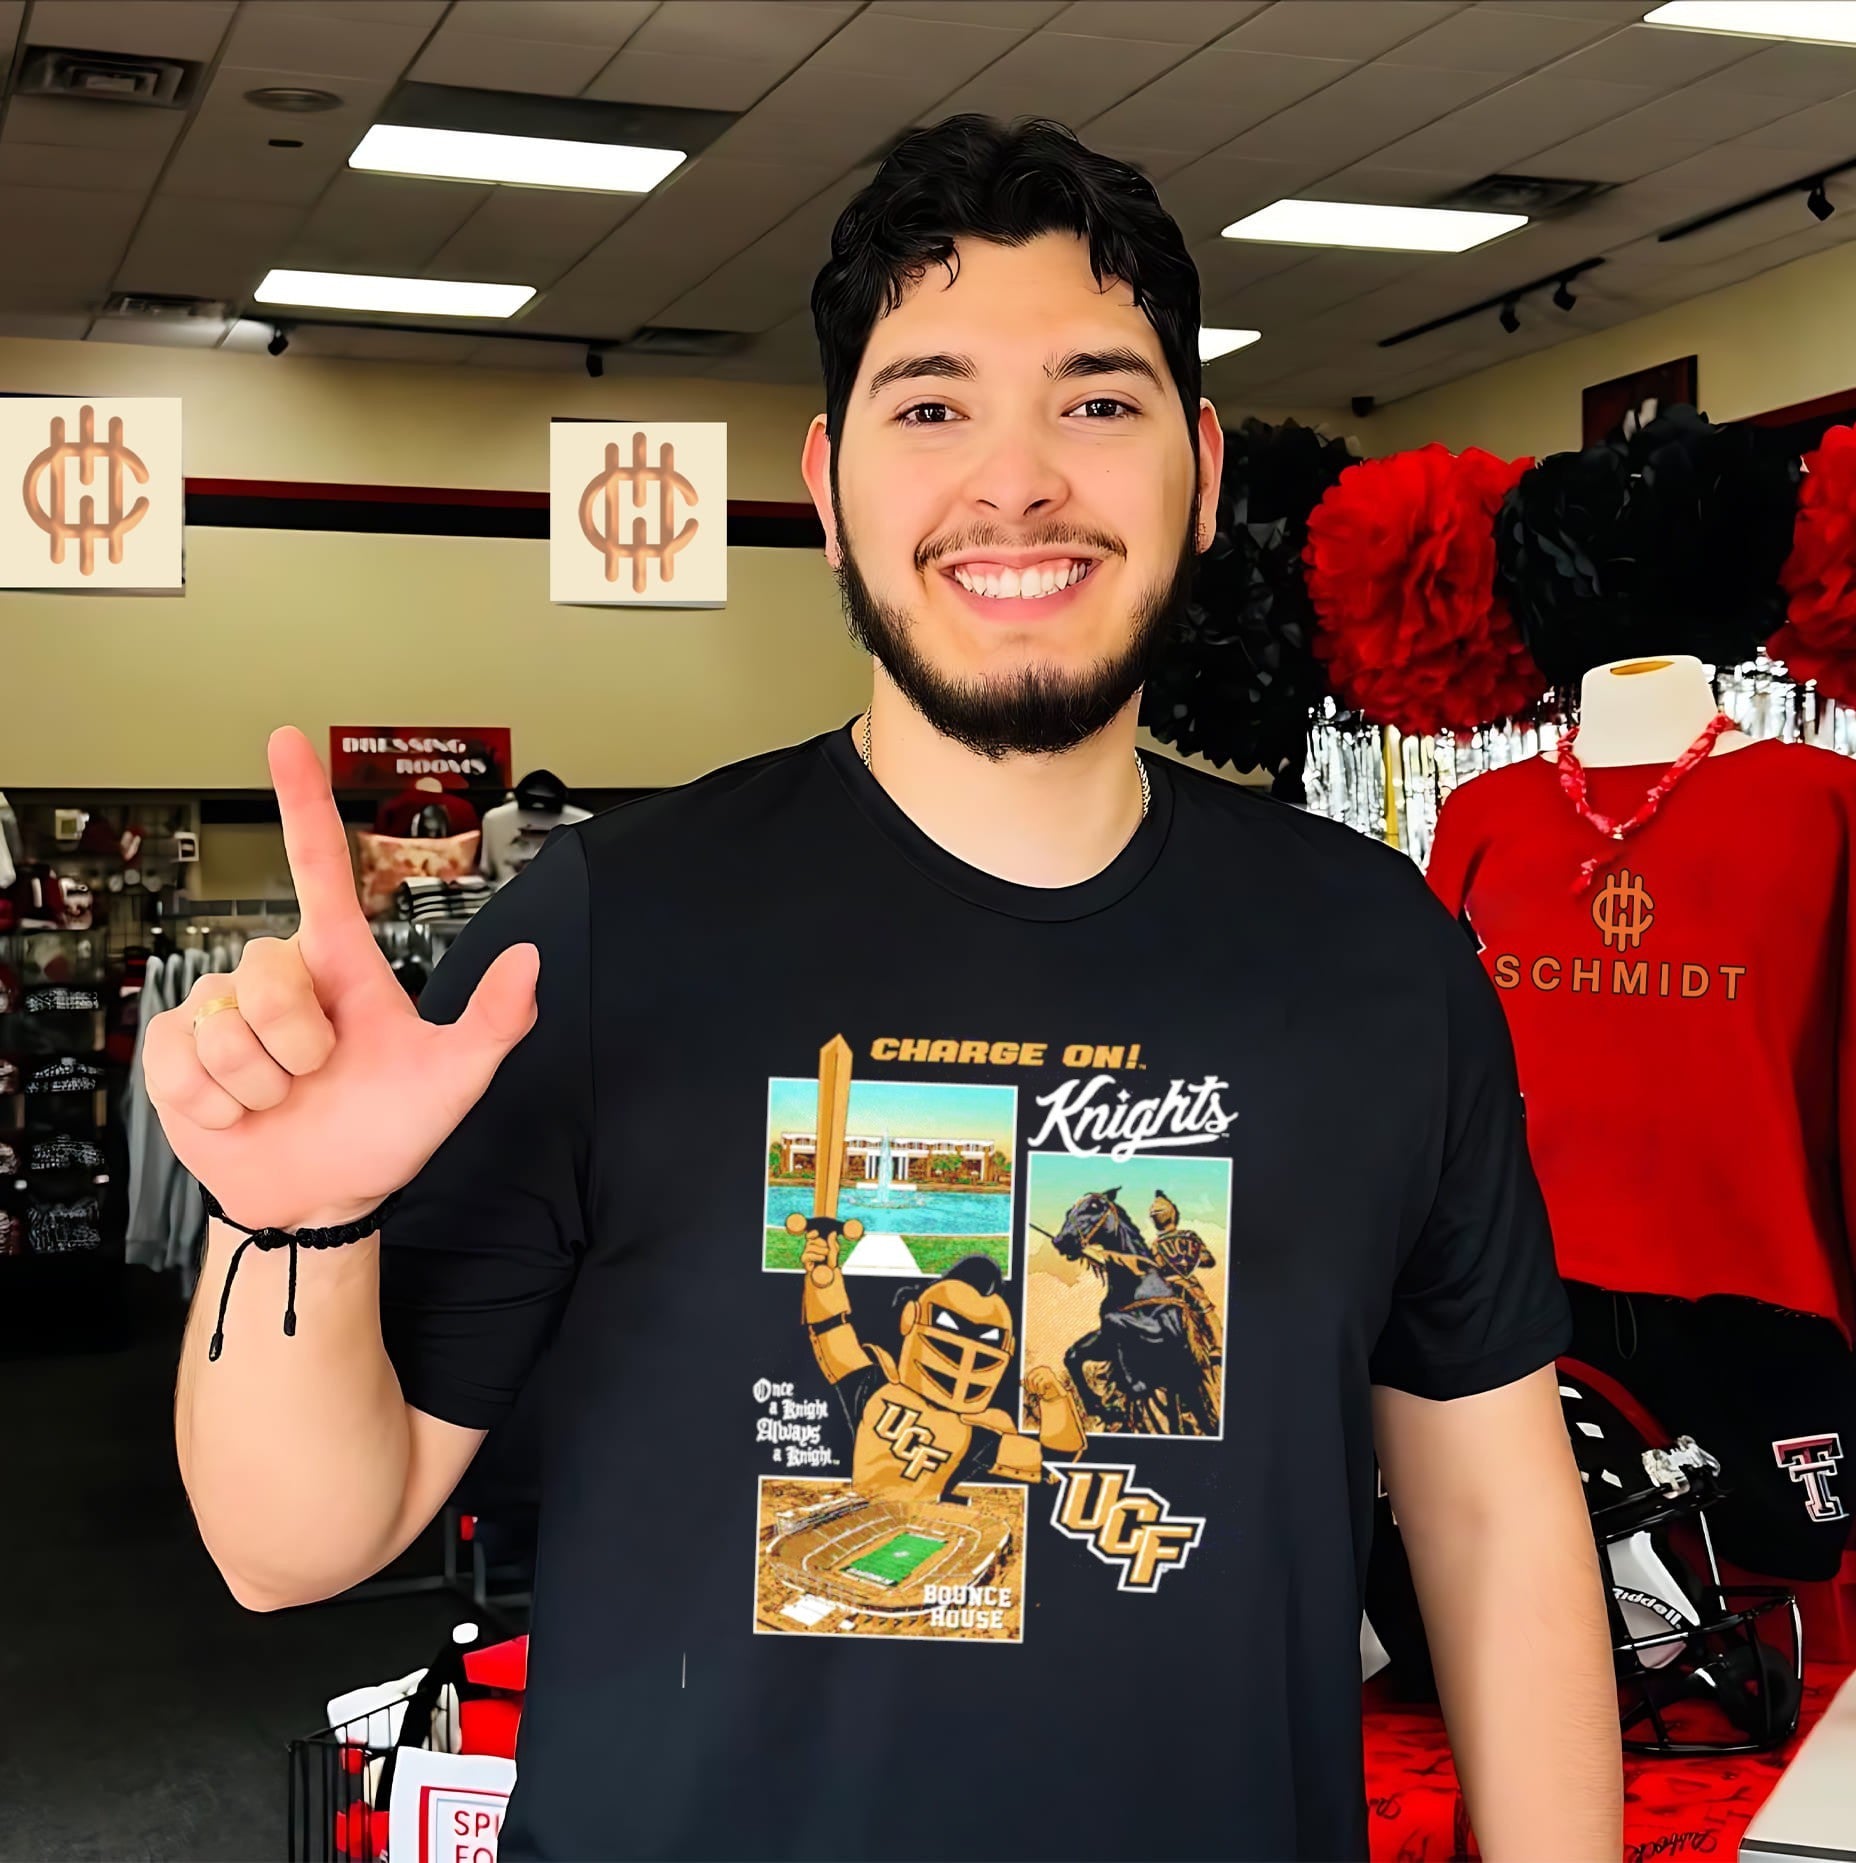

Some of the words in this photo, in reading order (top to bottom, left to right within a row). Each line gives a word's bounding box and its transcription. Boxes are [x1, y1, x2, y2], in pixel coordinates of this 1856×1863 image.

[342, 737, 467, 754] DRESSING
[396, 758, 487, 775] ROOMS
[1493, 953, 1748, 1000] SCHMIDT
[870, 1037, 1048, 1066] CHARGE
[1062, 1043, 1142, 1070] ON!
[1027, 1074, 1239, 1162] Knights
[752, 1377, 795, 1404] Once
[768, 1400, 778, 1416] a
[781, 1398, 830, 1421] Knight
[756, 1416, 822, 1447] Always
[873, 1400, 952, 1482] UCF
[772, 1447, 782, 1462] a
[785, 1444, 832, 1467] Knight
[1045, 1462, 1205, 1592] UCF
[923, 1583, 1012, 1609] BOUNCE
[929, 1607, 1005, 1630] HOUSE
[453, 1809, 501, 1838] SPI
